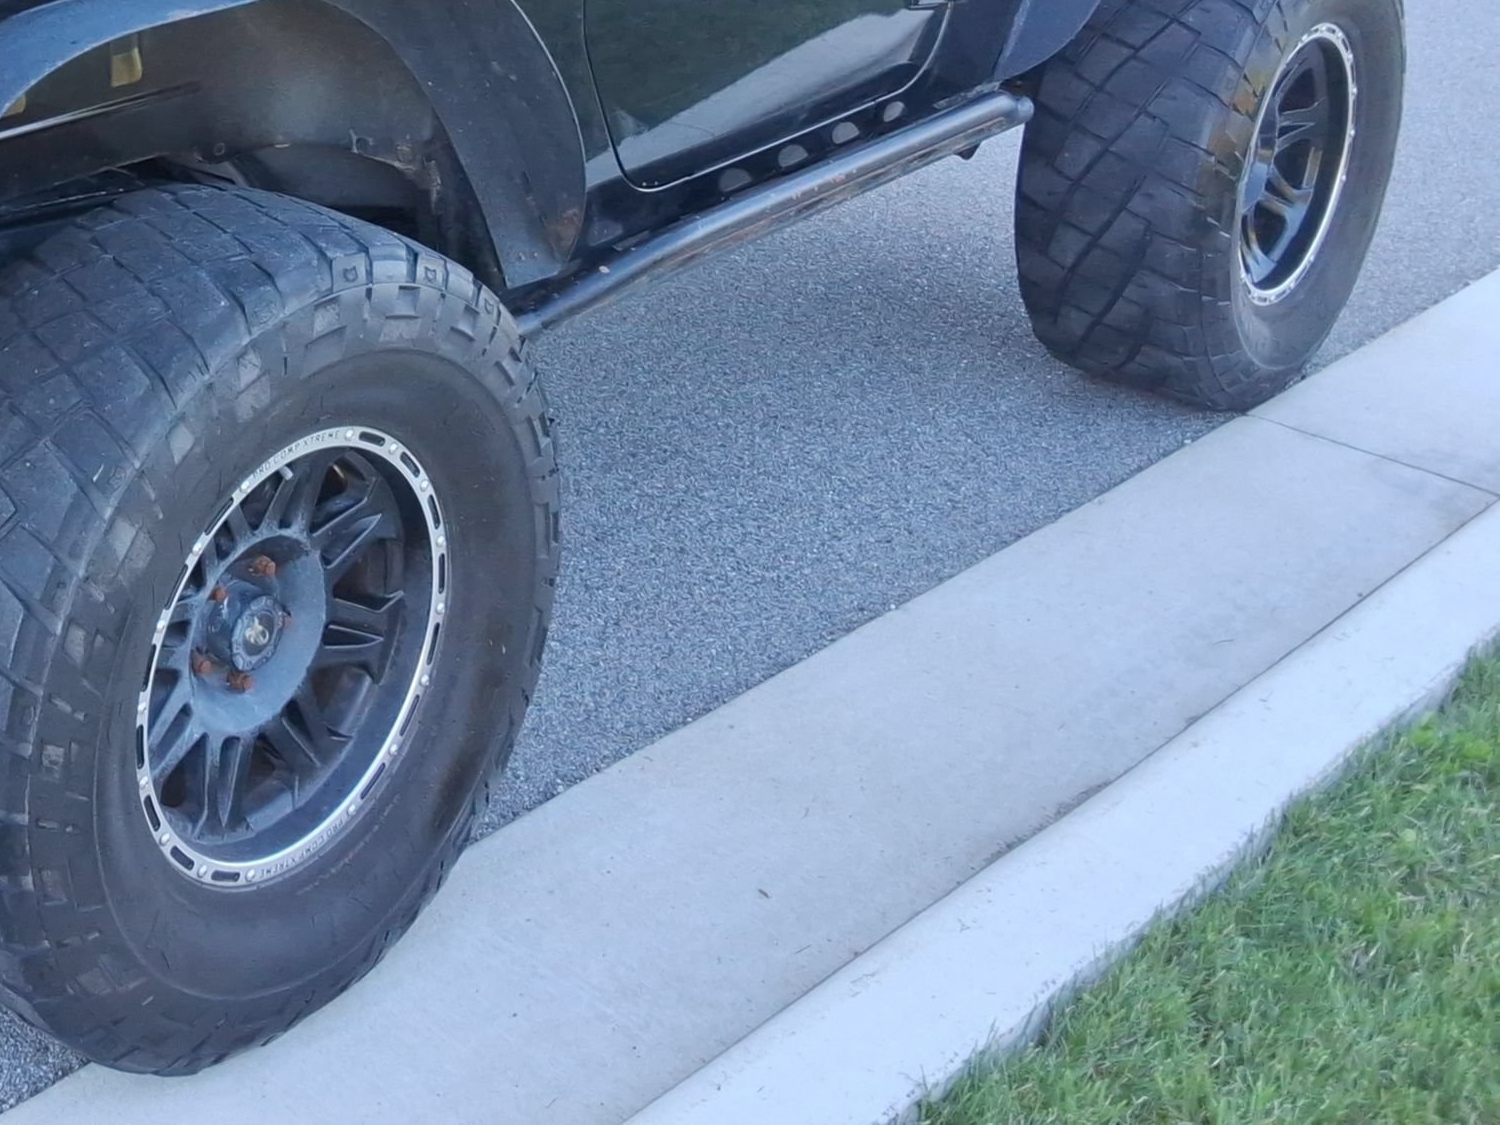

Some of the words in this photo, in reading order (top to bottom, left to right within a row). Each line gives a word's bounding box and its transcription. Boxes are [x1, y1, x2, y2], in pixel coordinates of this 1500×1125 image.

[252, 461, 272, 479] PRO
[273, 443, 301, 464] COMP
[302, 430, 340, 448] XTREME
